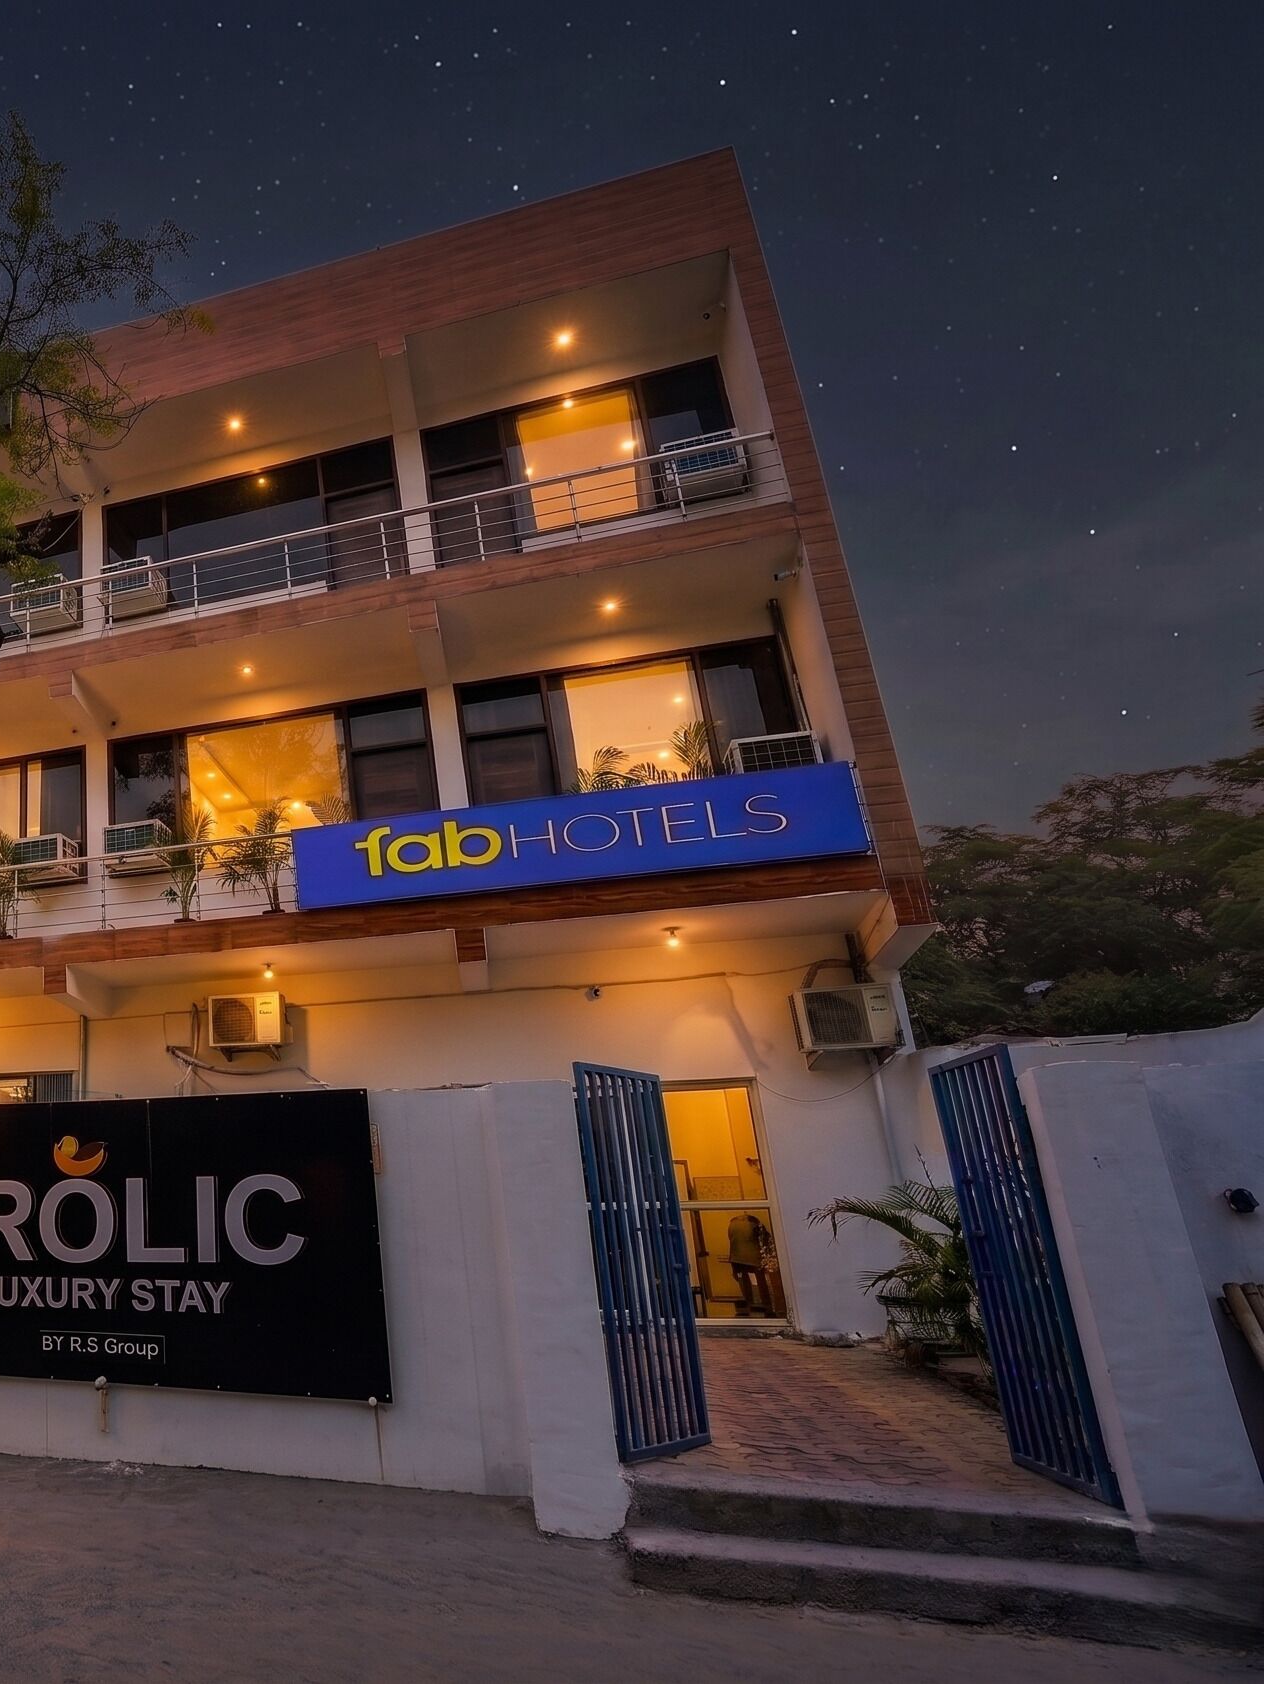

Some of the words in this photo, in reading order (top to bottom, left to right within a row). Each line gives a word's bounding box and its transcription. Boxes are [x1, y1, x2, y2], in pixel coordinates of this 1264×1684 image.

[130, 1278, 234, 1315] STAY
[42, 1335, 64, 1351] BY
[70, 1336, 99, 1353] R.S
[104, 1337, 159, 1360] Group
